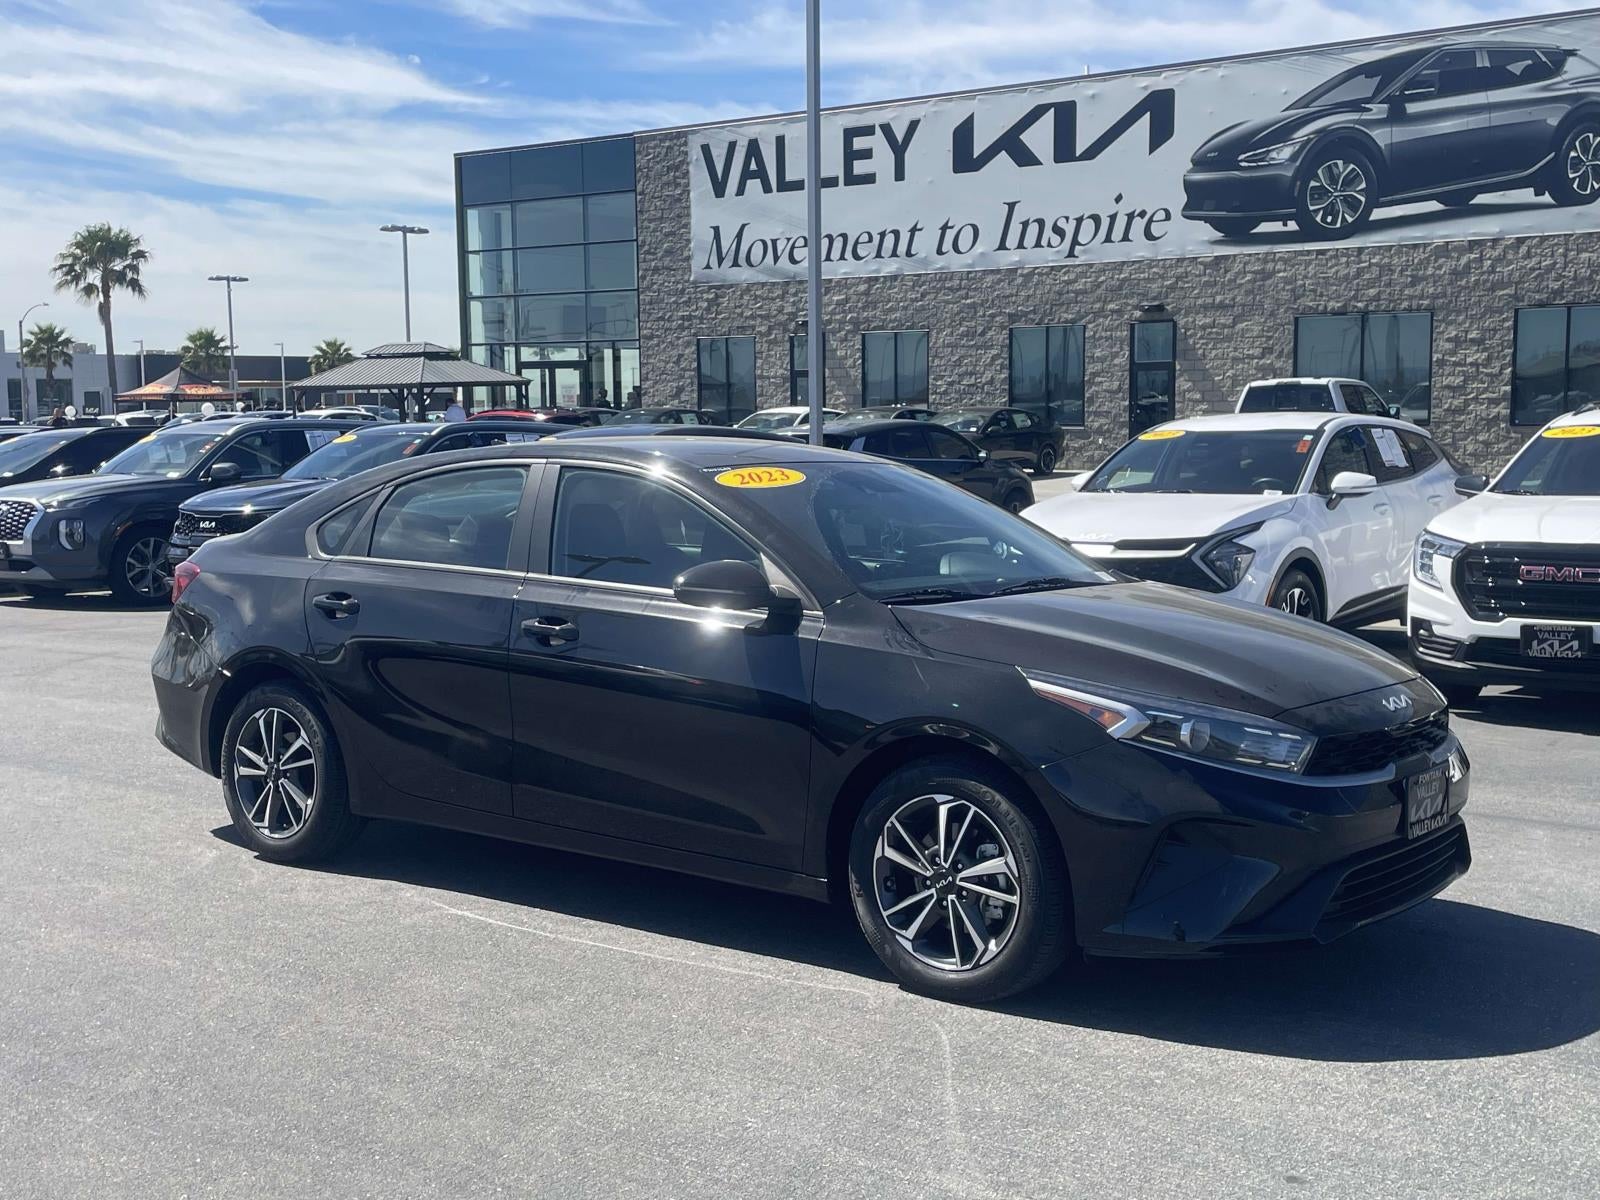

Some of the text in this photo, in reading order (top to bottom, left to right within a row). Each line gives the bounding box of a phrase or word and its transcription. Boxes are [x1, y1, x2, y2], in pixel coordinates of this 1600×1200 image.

[701, 88, 1175, 198] VALEY KIA
[703, 193, 1172, 270] Movement to Inspire
[733, 469, 790, 485] 2023
[200, 520, 216, 528] KIA
[1519, 565, 1600, 583] GMC
[1537, 631, 1573, 640] VALLEY
[1528, 649, 1582, 659] VALLEY KIA
[1532, 639, 1579, 652] KIA
[1382, 694, 1413, 711] KIA
[1416, 782, 1440, 800] VALLEY
[1411, 793, 1443, 823] KIA
[1412, 813, 1447, 839] VALLEY KIA
[935, 875, 953, 889] KIA
